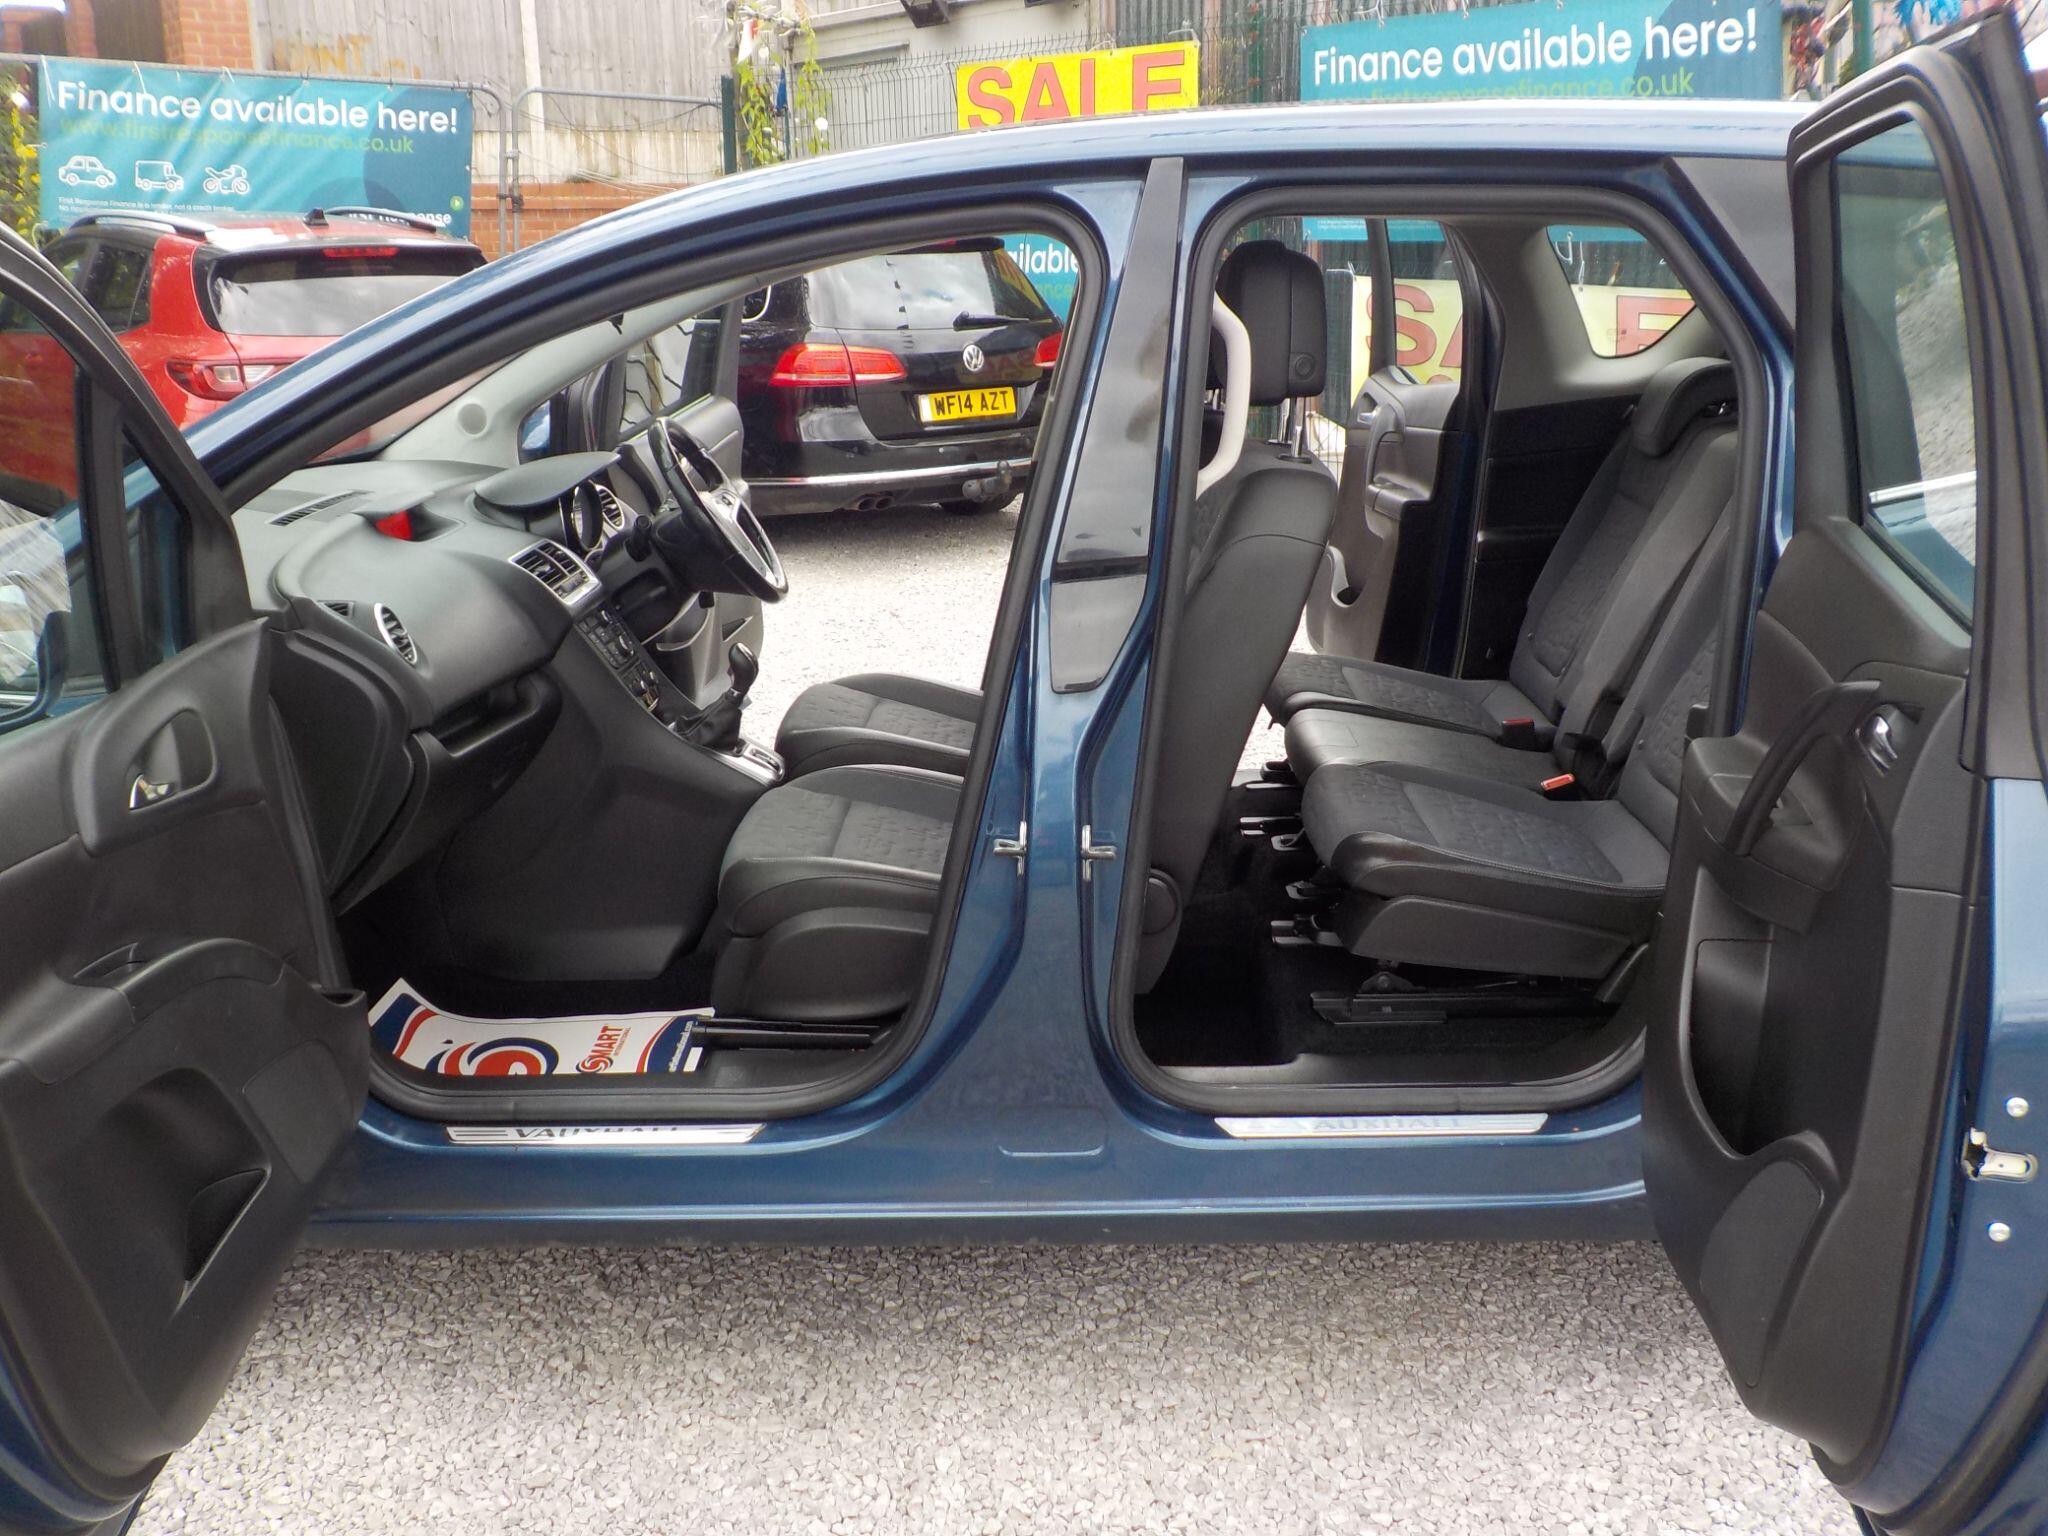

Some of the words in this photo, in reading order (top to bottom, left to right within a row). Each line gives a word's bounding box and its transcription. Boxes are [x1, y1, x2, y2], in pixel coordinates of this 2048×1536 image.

[1313, 45, 1443, 86] Finance
[1453, 21, 1633, 76] available
[1644, 8, 1757, 60] here!
[57, 81, 202, 119] Finance
[210, 95, 369, 128] available
[377, 100, 458, 134] here!
[934, 393, 973, 416] WF14
[980, 390, 1008, 412] AZT
[577, 1024, 622, 1073] SMART
